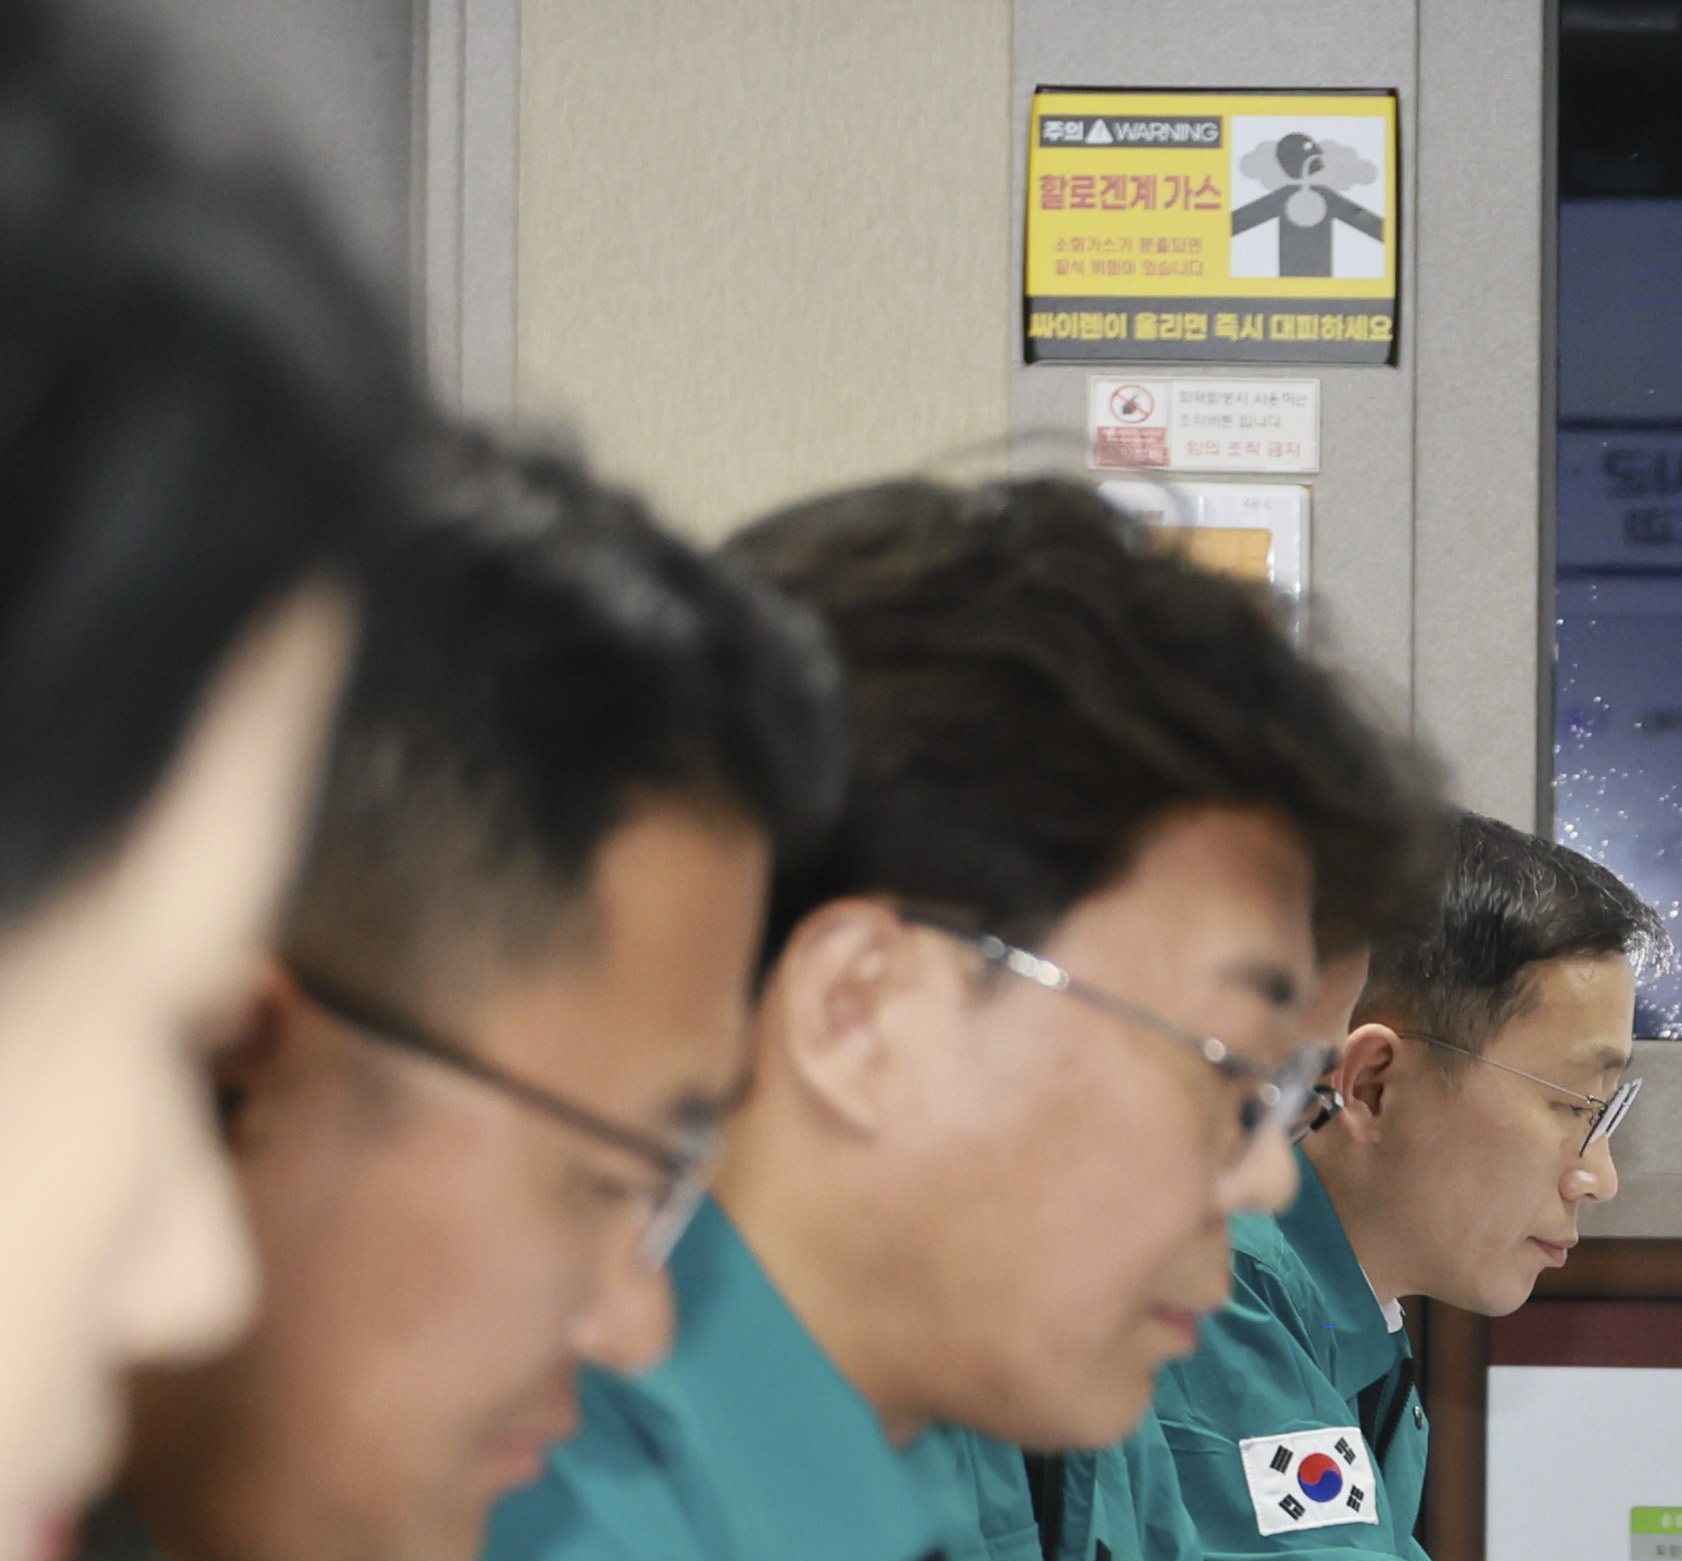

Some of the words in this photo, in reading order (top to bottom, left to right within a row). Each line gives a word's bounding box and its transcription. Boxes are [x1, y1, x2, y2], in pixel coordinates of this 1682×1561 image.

[1043, 120, 1084, 141] 주의
[1113, 122, 1219, 142] WARNING
[1039, 174, 1158, 210] 할로겐계
[1163, 174, 1222, 210] 가스
[1029, 312, 1128, 340] 싸이렌이
[1134, 312, 1208, 341] 울리면
[1214, 313, 1264, 342] 즉시
[1270, 314, 1393, 343] 대피하세요
